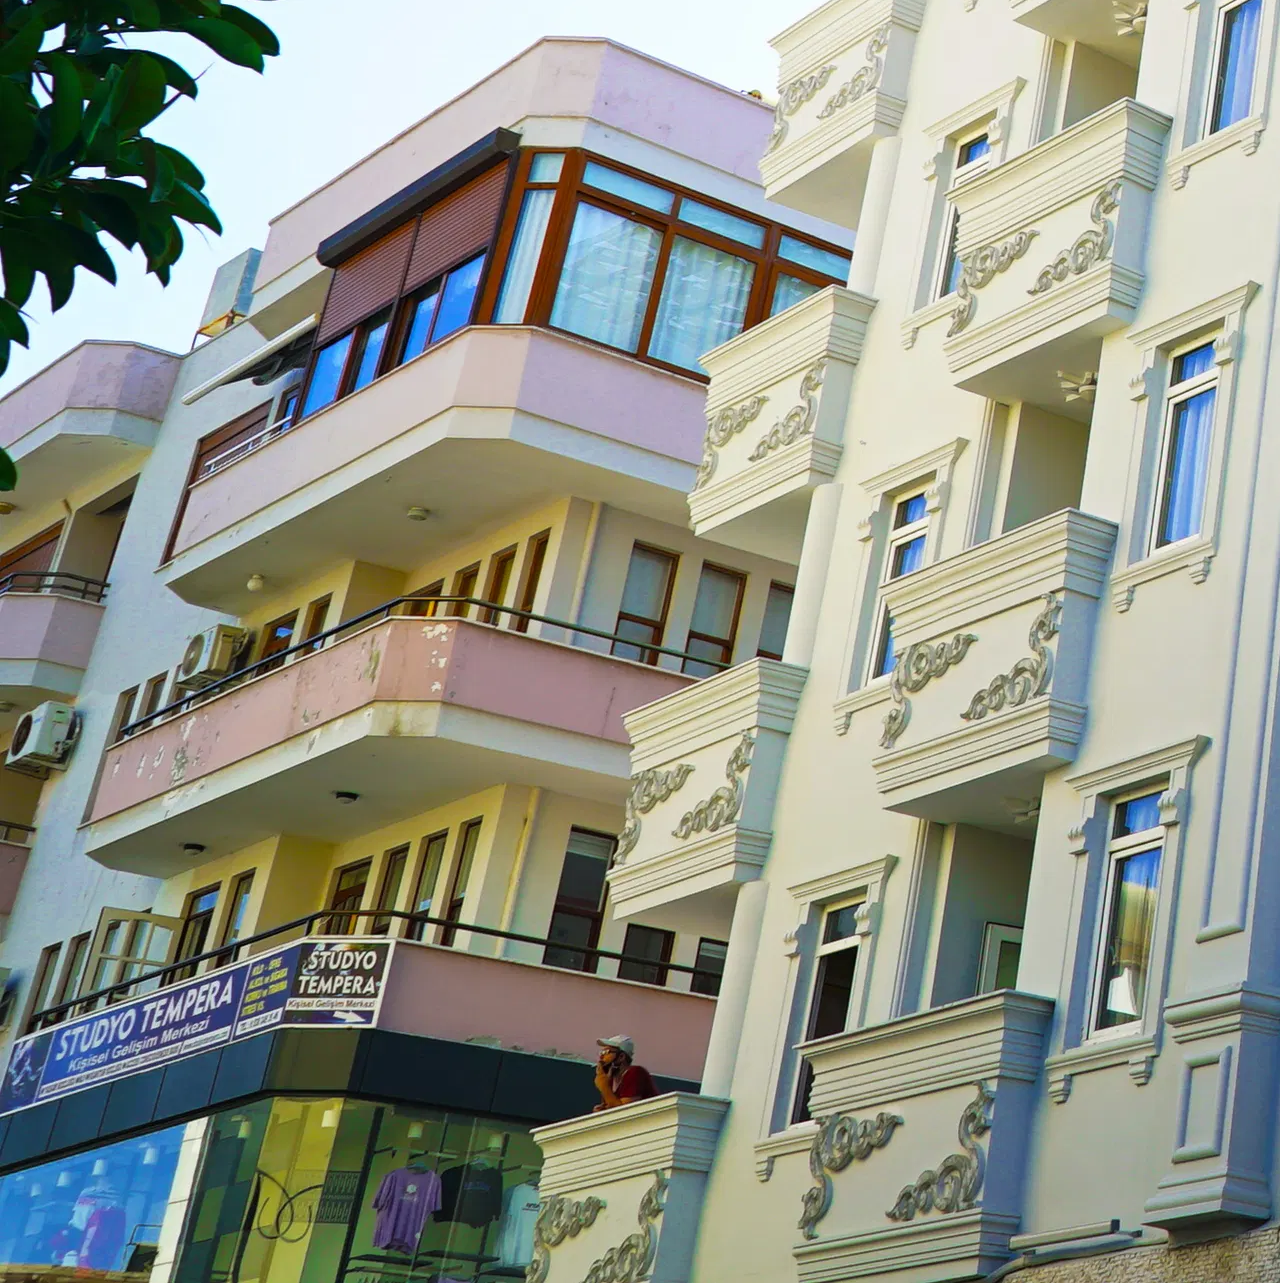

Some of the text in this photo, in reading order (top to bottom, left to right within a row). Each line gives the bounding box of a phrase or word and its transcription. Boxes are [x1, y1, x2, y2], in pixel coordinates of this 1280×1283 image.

[298, 975, 375, 994] TEMPERA
[139, 974, 234, 1034] TEMPERA
[160, 1015, 211, 1044] Merkezi
